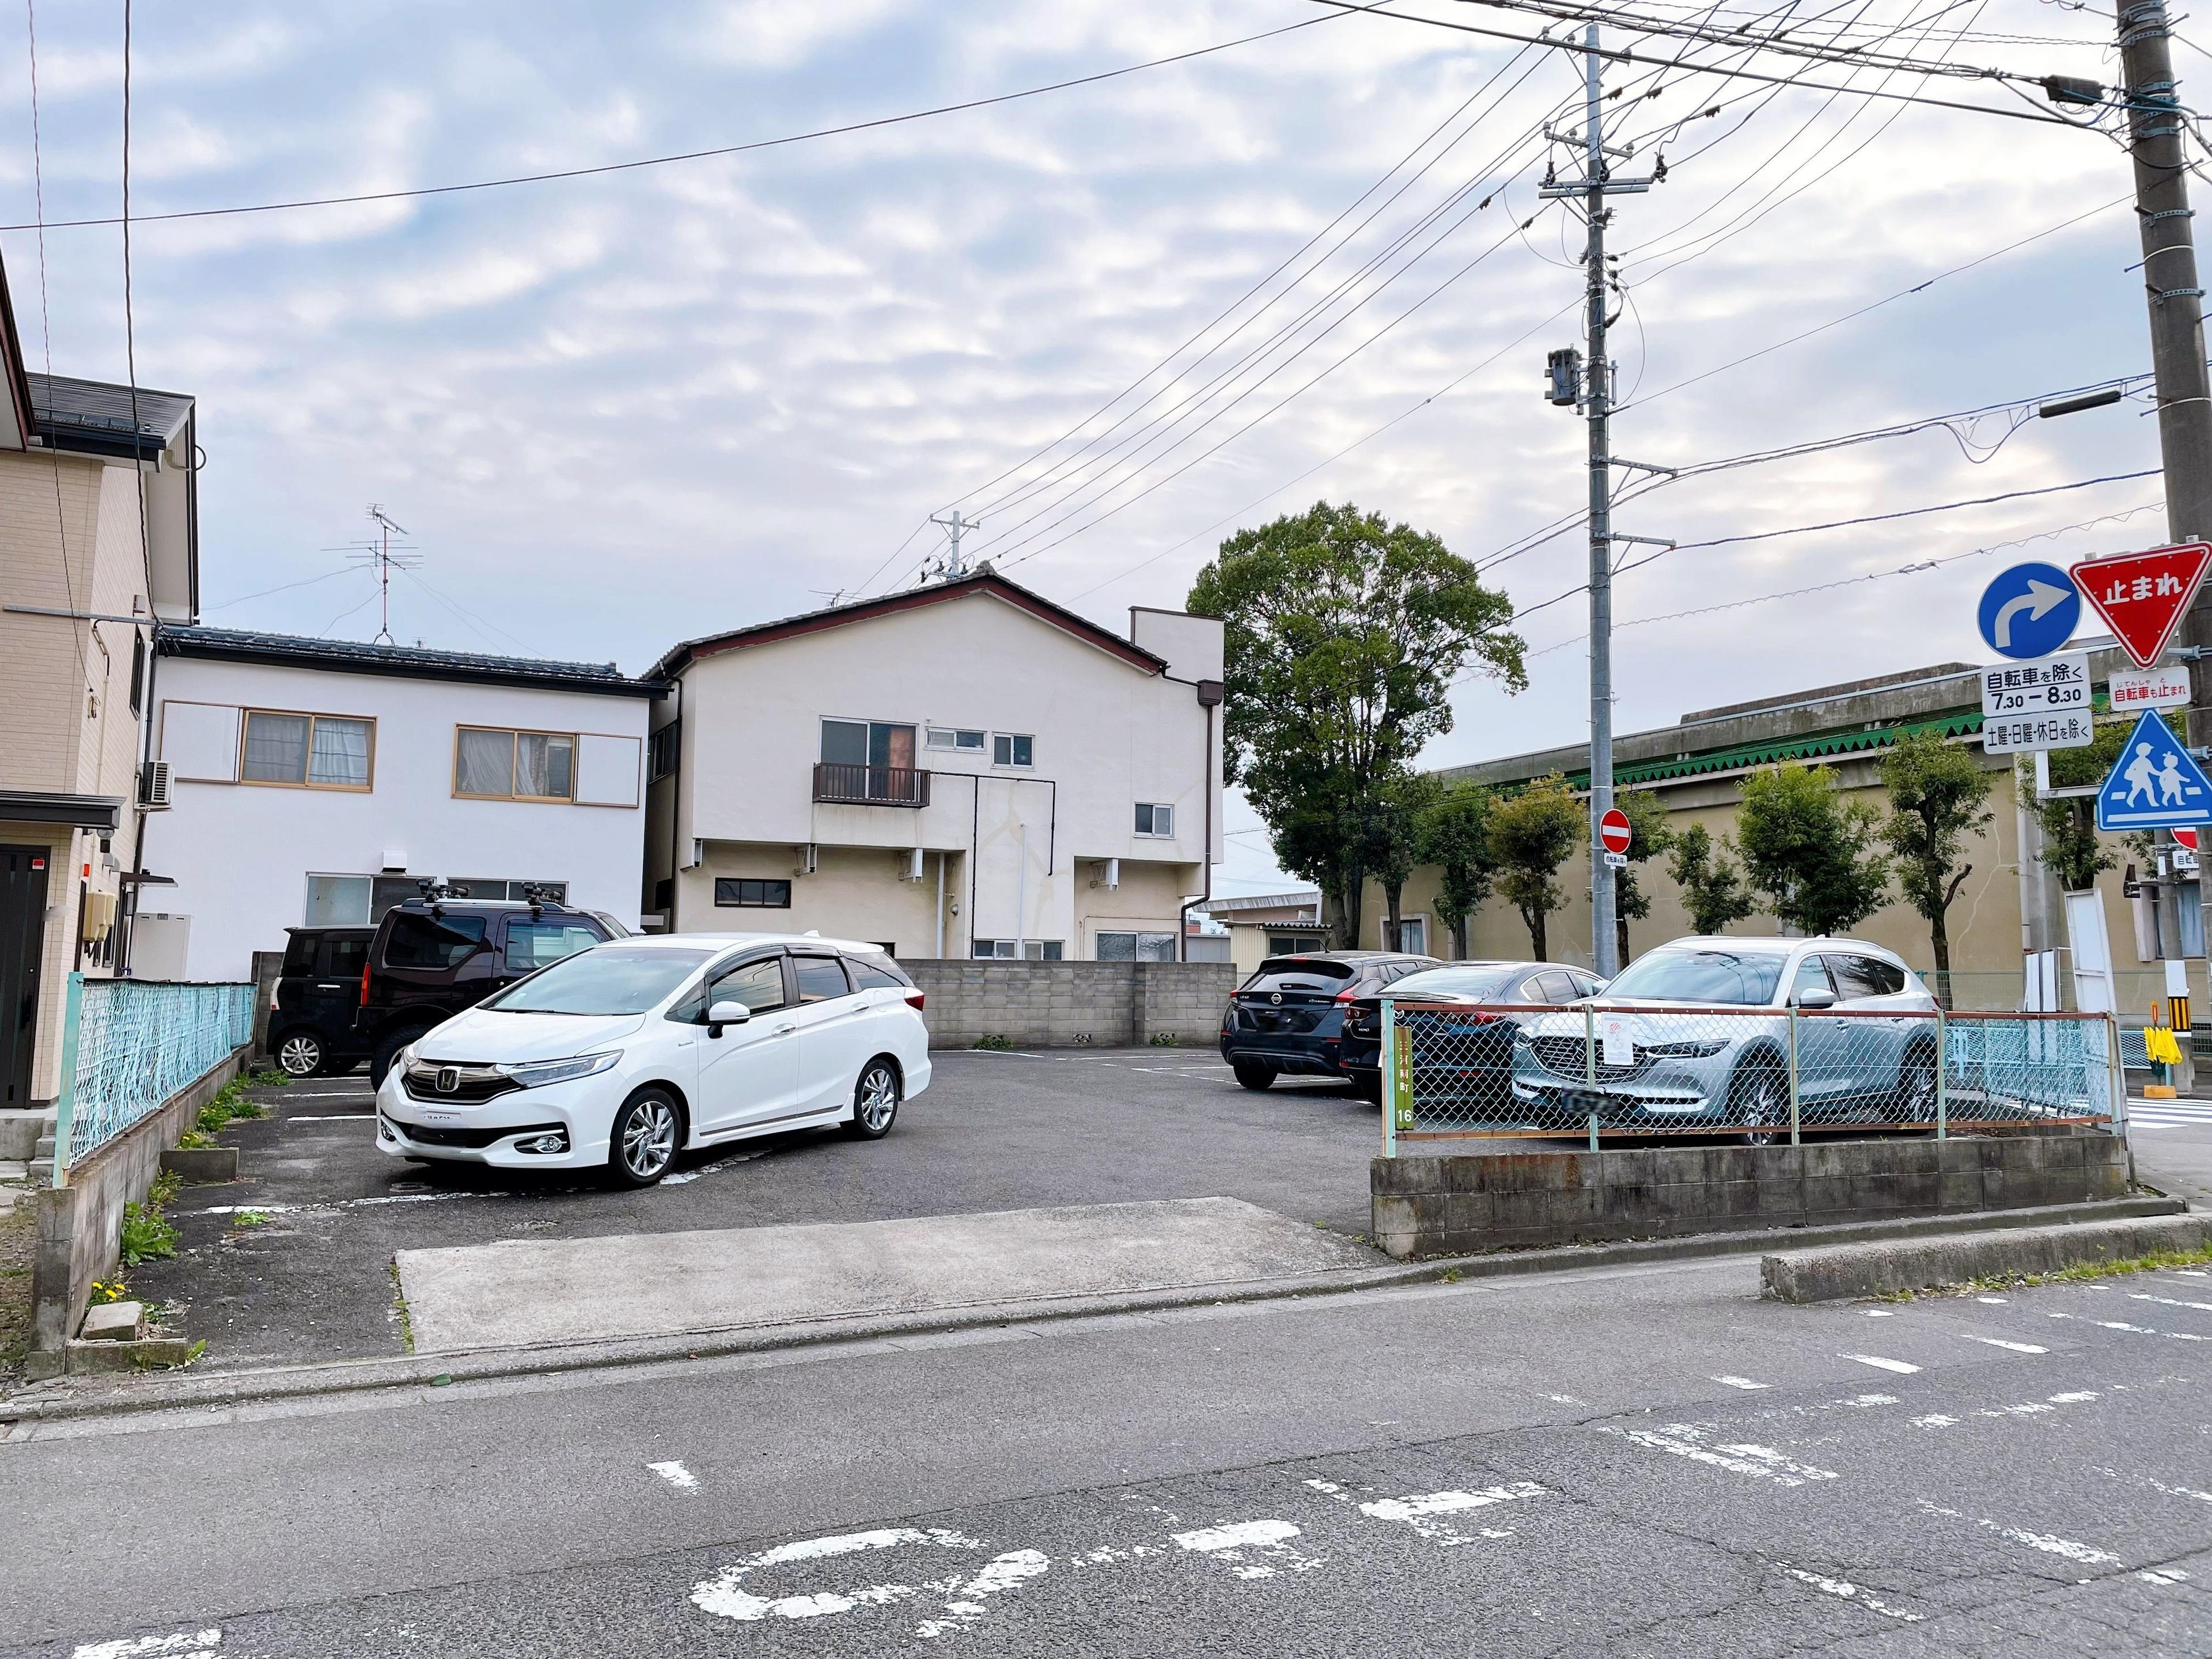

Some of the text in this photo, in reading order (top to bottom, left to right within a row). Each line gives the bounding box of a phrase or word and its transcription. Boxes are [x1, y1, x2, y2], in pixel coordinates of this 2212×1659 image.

[2104, 573, 2183, 605] 止まれ
[1987, 664, 2082, 690] 自転車を除く
[2117, 680, 2151, 688] じてんしゃ
[2115, 684, 2186, 702] 自転車も止まれ
[1988, 718, 2089, 747] 土曜・日曜・休日を除く
[1397, 1109, 1412, 1123] 16
